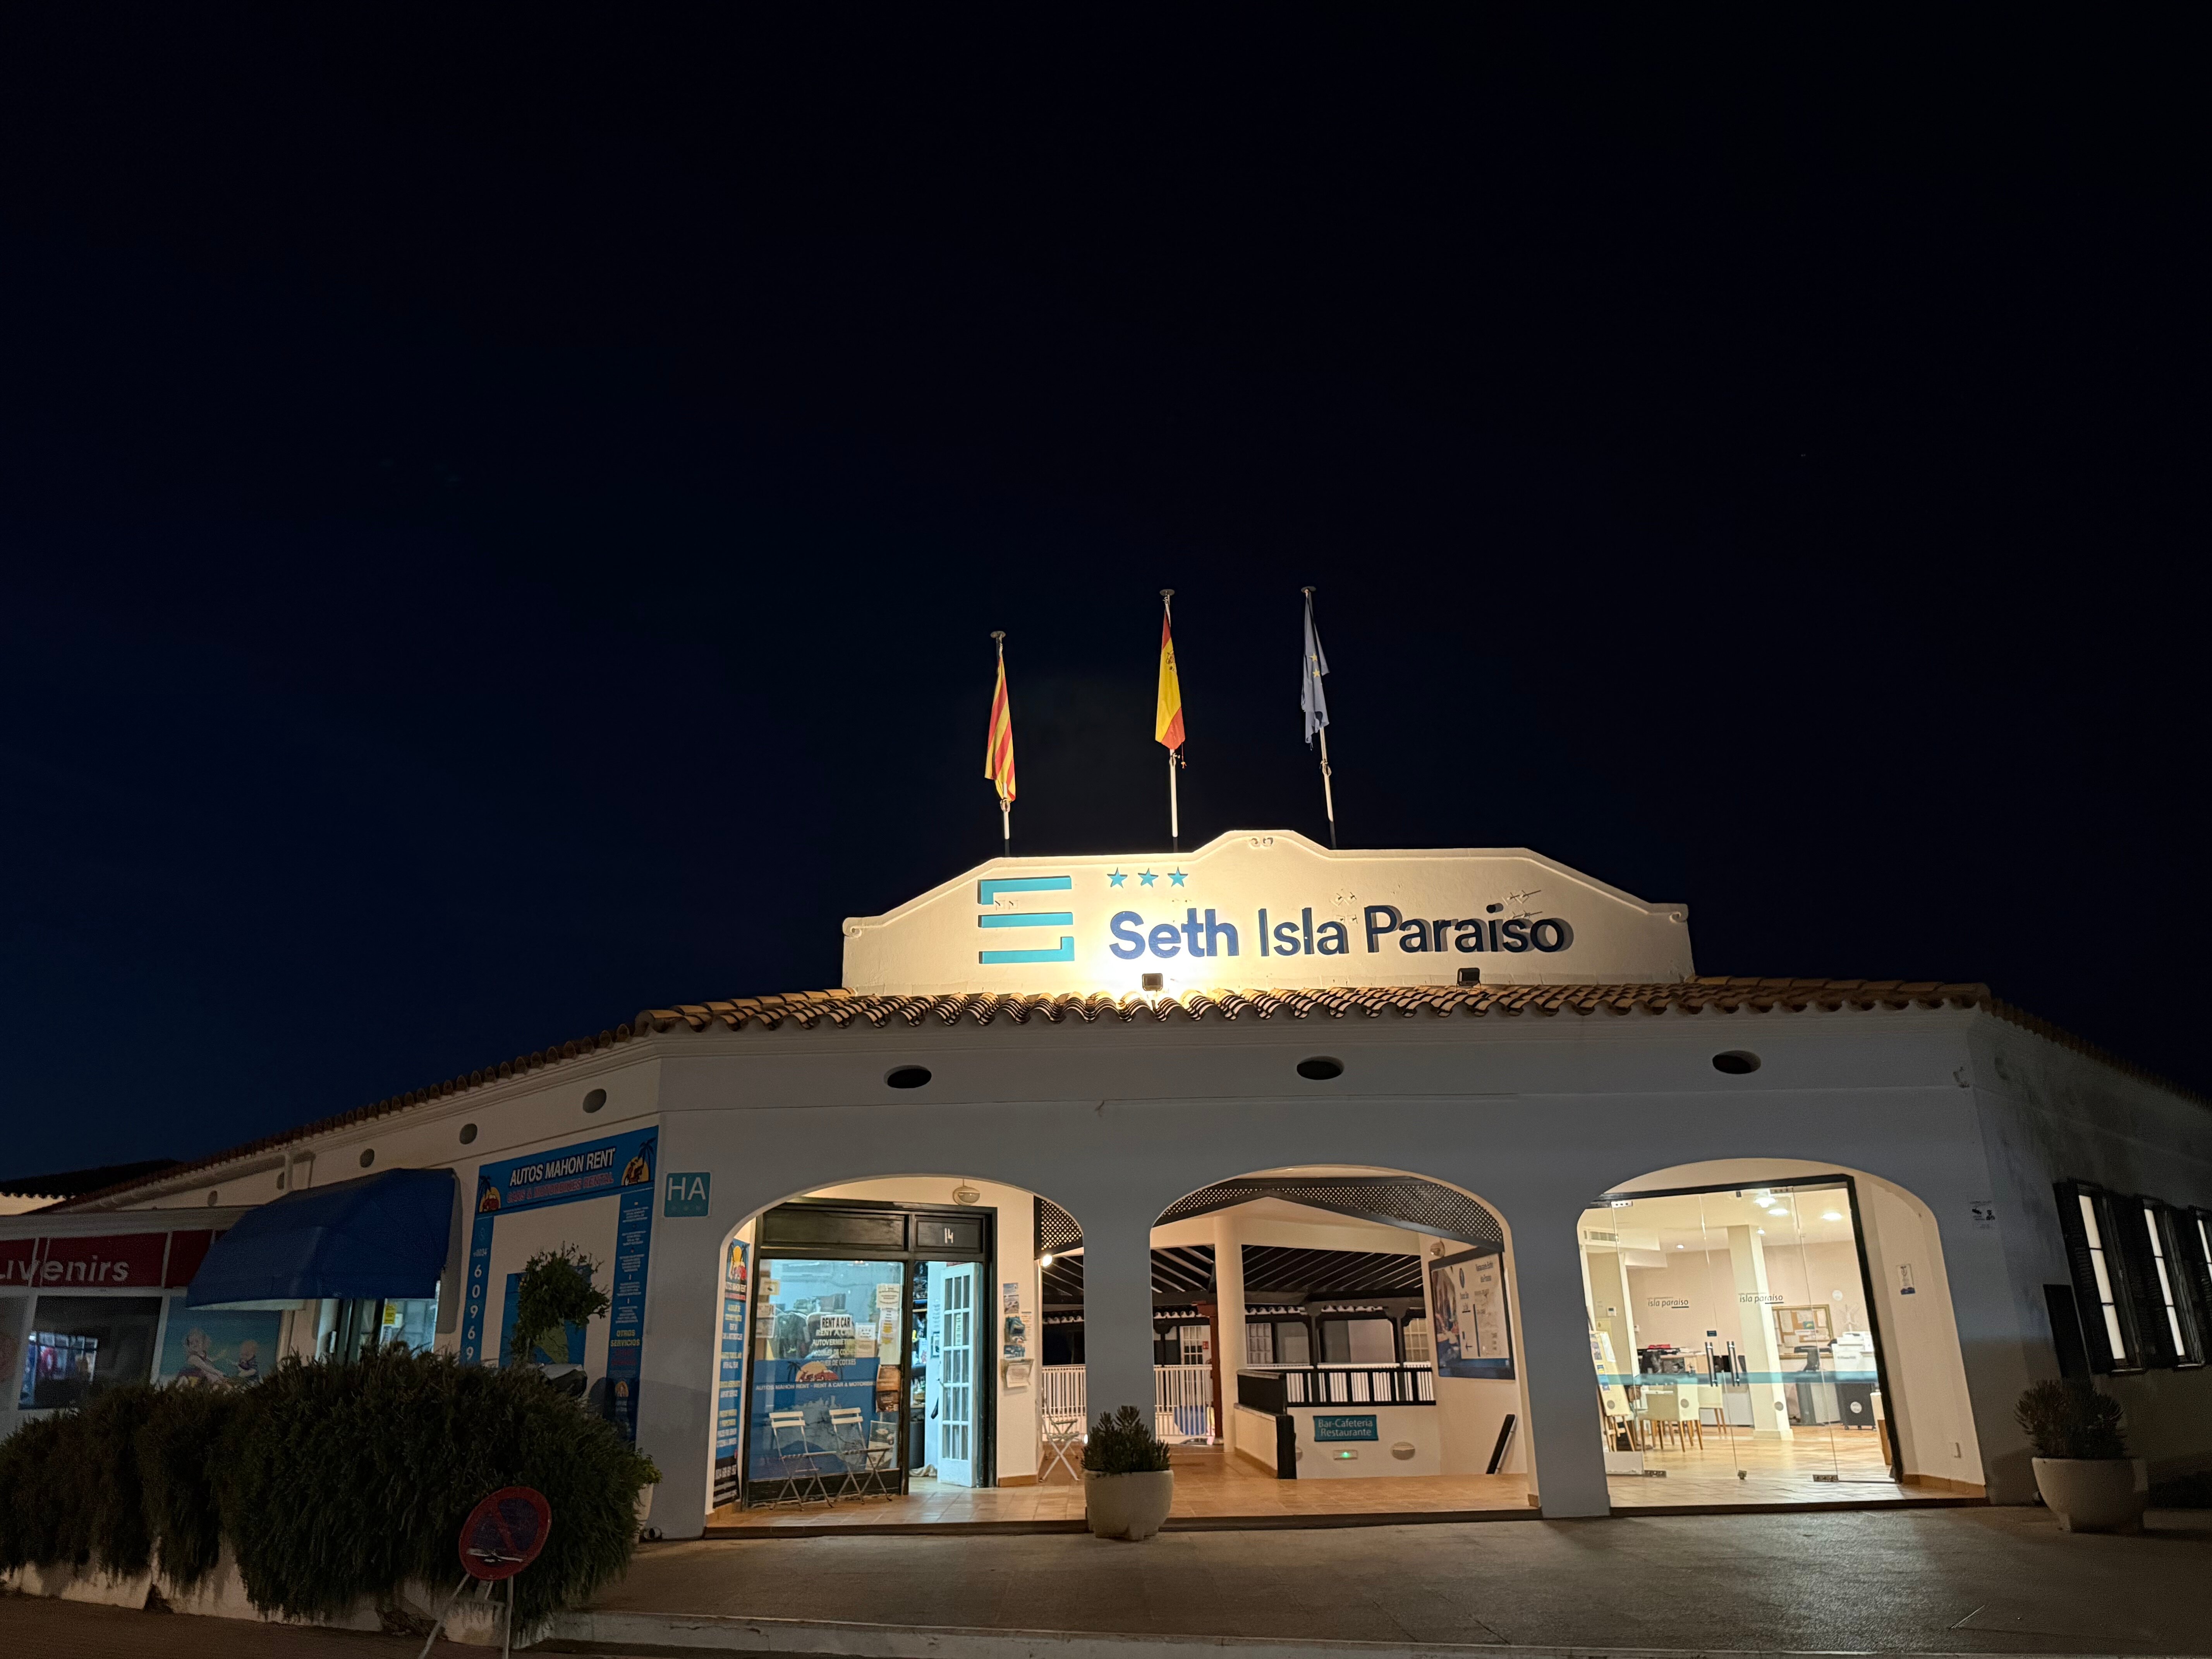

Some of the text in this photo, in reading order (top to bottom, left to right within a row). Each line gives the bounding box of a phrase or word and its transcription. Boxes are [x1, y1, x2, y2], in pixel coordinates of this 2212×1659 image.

[1109, 904, 1570, 960] Seth Isla Paraiso
[510, 1148, 615, 1186] AUTOS MAHON RENT
[668, 1177, 706, 1200] HA
[945, 1228, 953, 1244] 14
[1648, 1298, 1660, 1306] isla
[822, 1317, 850, 1328] RENT A CAR
[611, 1339, 640, 1347] SERVICIOS
[1321, 1428, 1372, 1437] Restaurante
